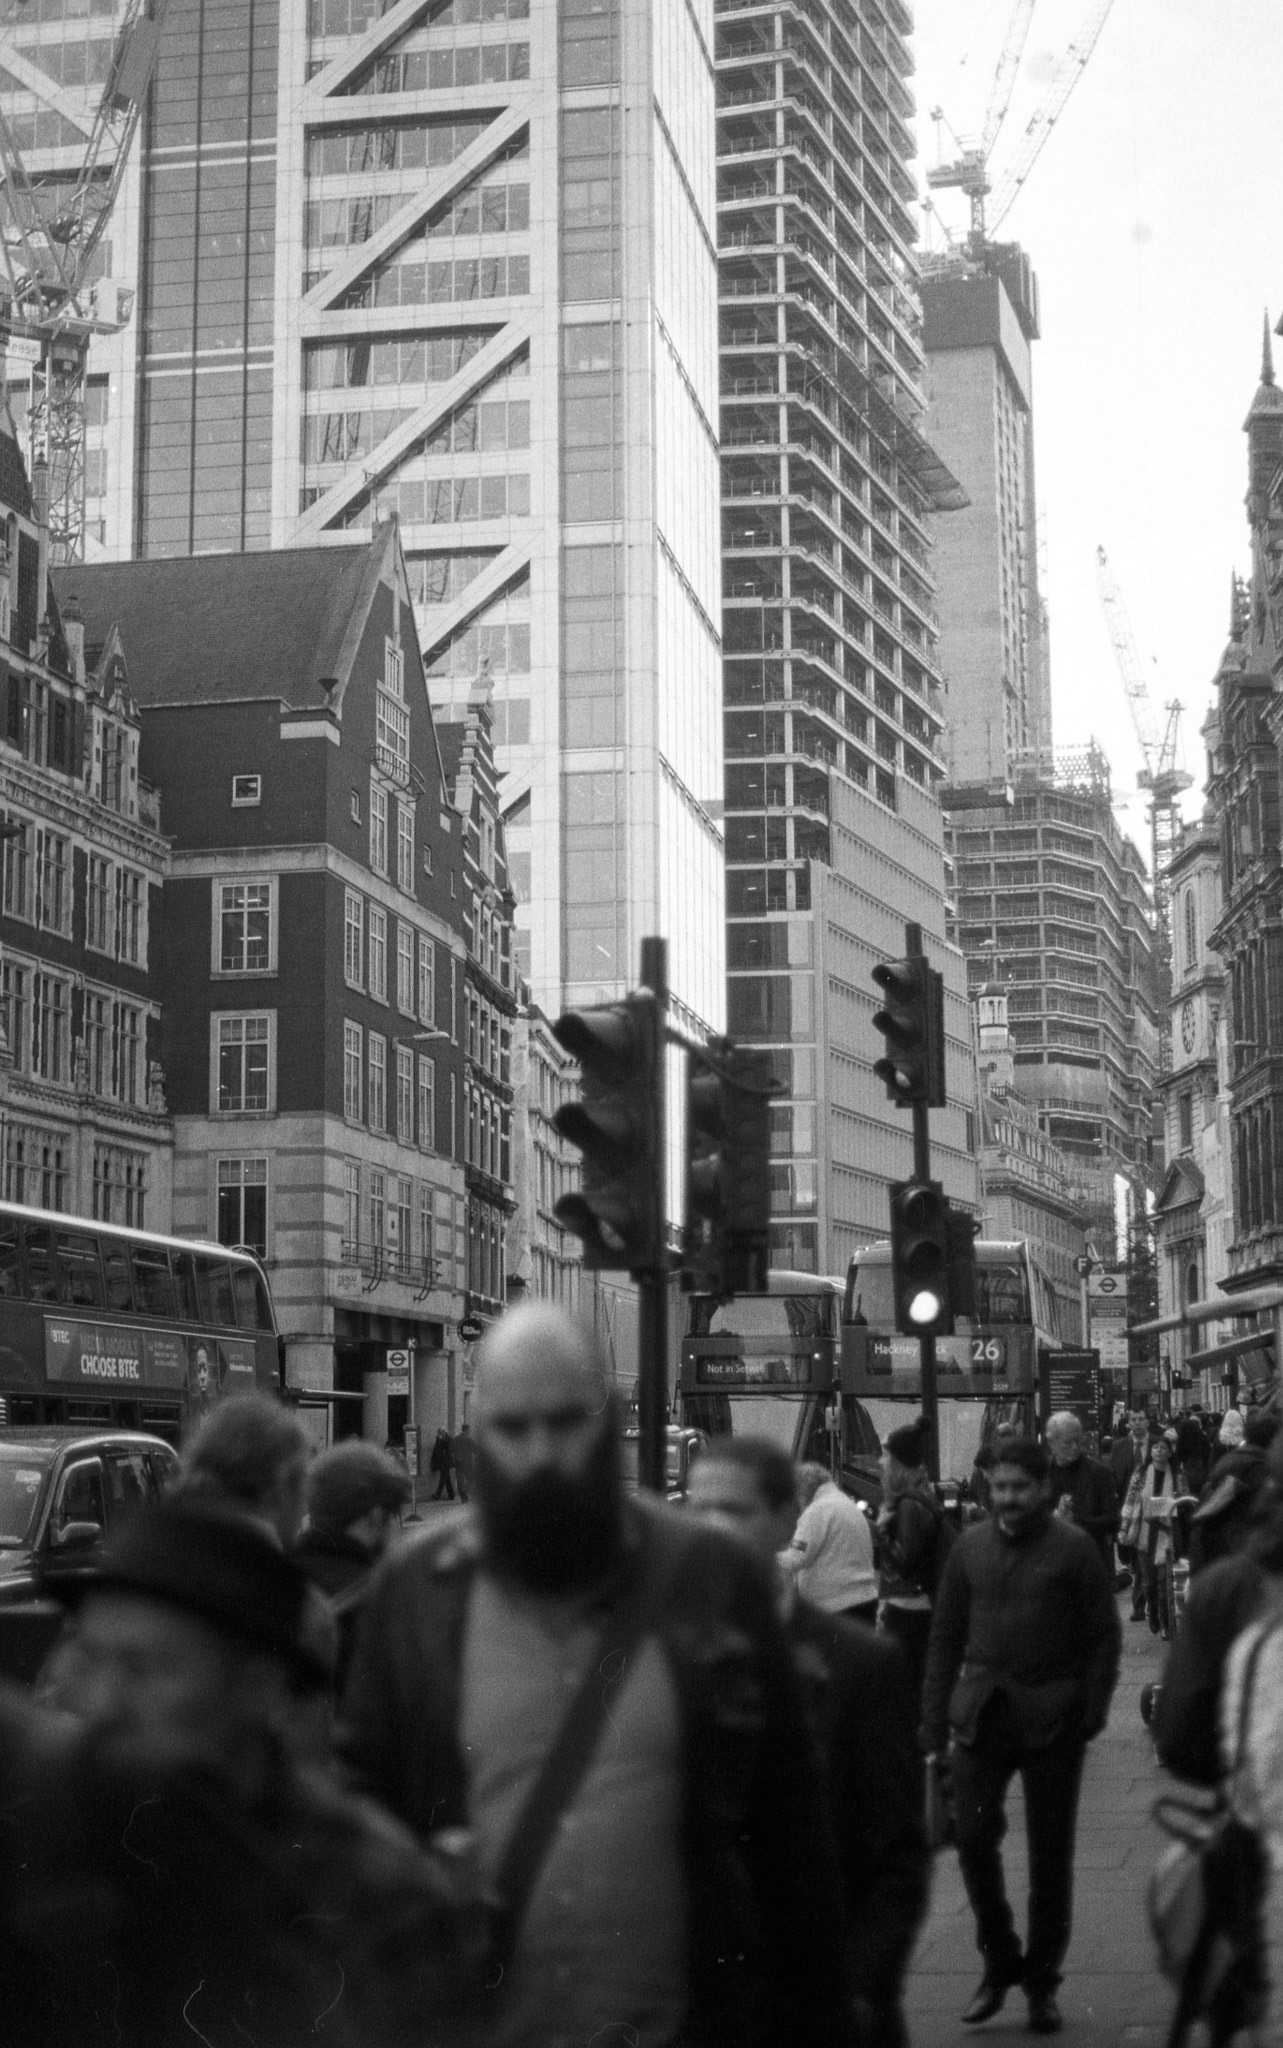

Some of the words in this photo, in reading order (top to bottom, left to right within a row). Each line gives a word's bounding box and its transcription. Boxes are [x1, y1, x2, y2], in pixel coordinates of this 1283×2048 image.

[1078, 1258, 1087, 1272] F
[52, 1329, 70, 1343] BTEC
[408, 1338, 416, 1348] K
[874, 1343, 919, 1357] Hackney
[972, 1339, 1000, 1360] 26
[81, 1353, 117, 1377] CHOOSE
[118, 1358, 140, 1379] BTEC
[707, 1364, 723, 1374] Not
[725, 1364, 734, 1374] in
[735, 1363, 766, 1374] Service
